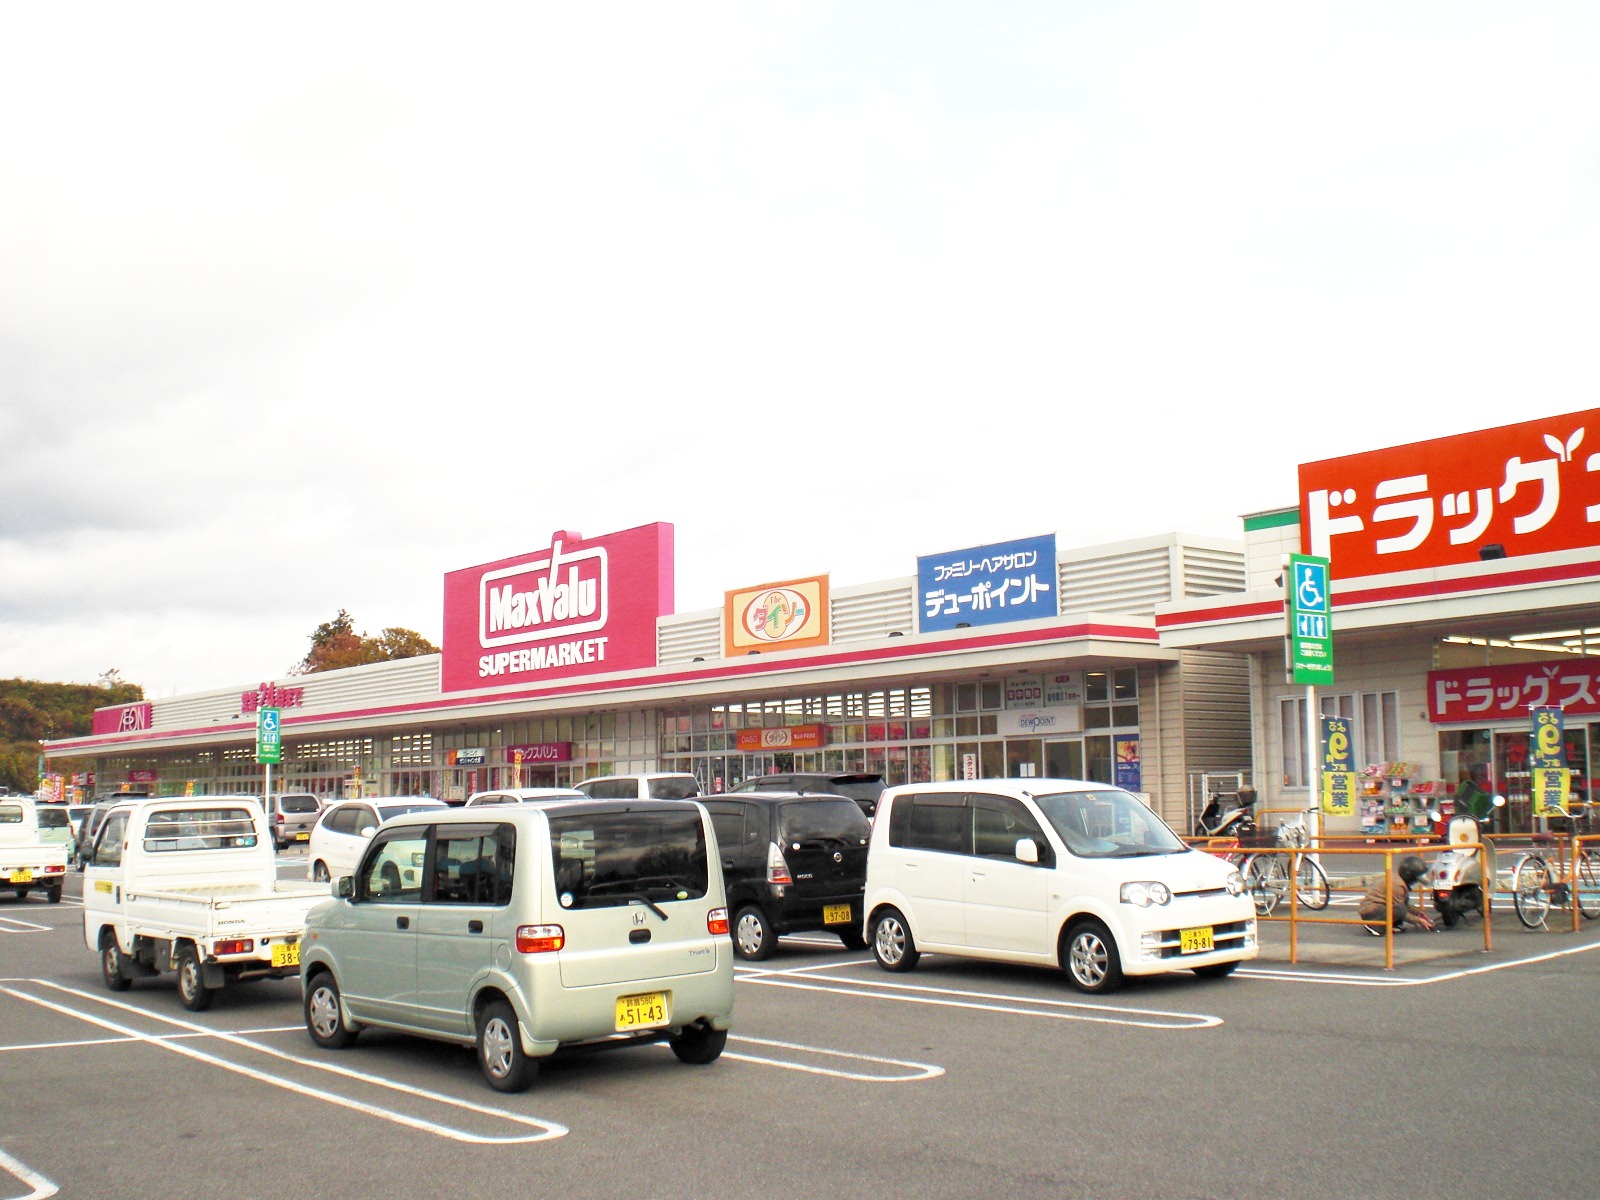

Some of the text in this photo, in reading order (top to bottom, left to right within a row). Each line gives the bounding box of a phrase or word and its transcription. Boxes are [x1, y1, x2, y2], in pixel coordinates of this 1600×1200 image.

[1308, 427, 1600, 563] ドラッグ
[934, 550, 1037, 581] ファミリーヘアサロン
[489, 541, 597, 633] MaxValu
[925, 573, 1050, 618] デューポイント
[753, 601, 805, 631] ダイソー
[479, 637, 608, 677] SUPERMARKET
[1435, 665, 1600, 714] ドラッグス
[1188, 937, 1211, 950] 79-81
[626, 1005, 663, 1024] 51-43
